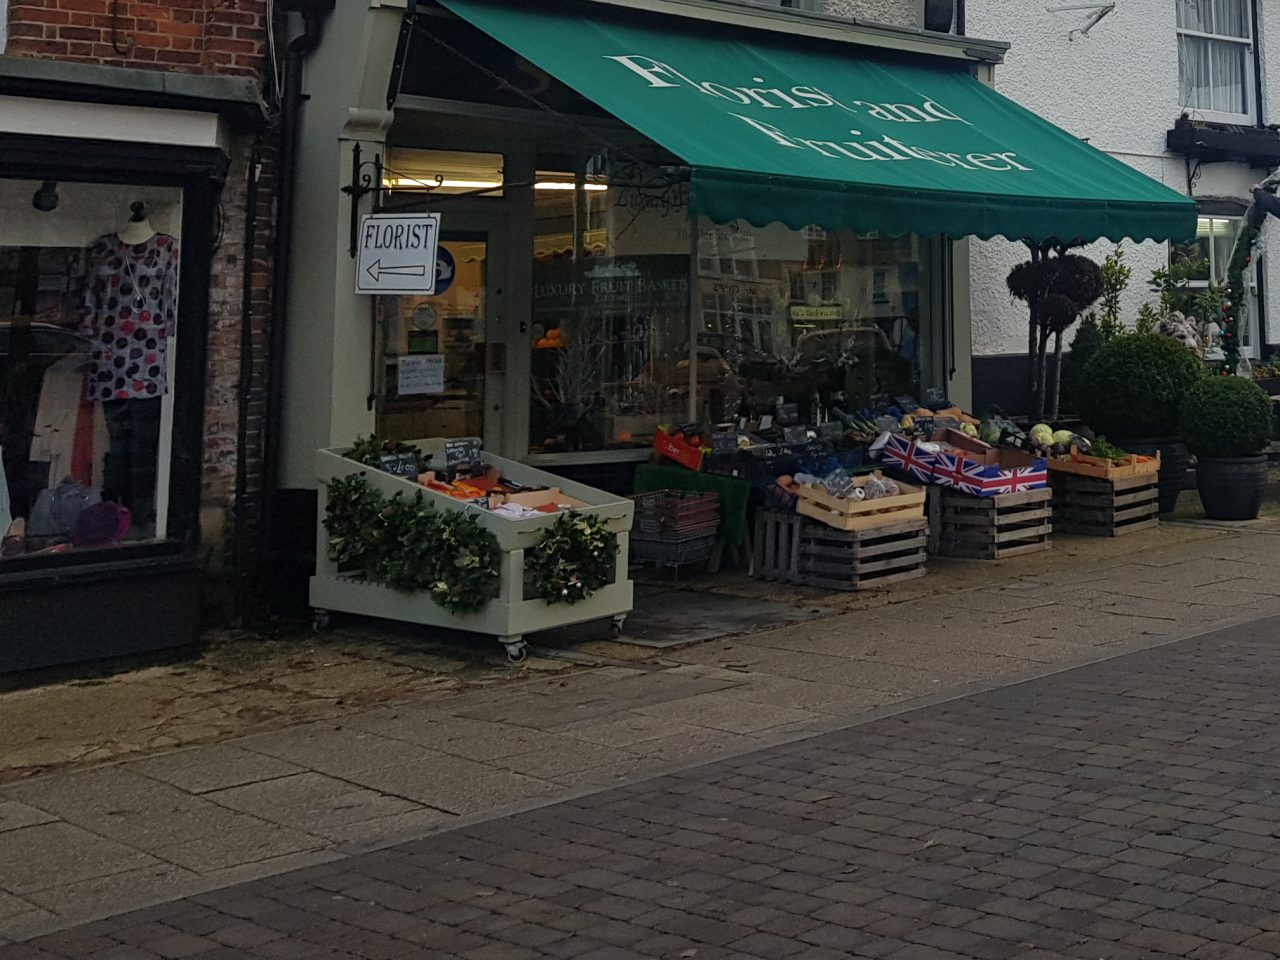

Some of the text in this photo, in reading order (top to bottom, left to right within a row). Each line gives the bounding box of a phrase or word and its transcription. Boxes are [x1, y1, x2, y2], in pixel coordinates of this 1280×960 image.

[602, 54, 974, 127] Florist and
[728, 111, 1034, 172] Fruiterer
[364, 223, 433, 251] FLORIST
[534, 282, 585, 298] LUXURY
[592, 279, 632, 295] FRUIT
